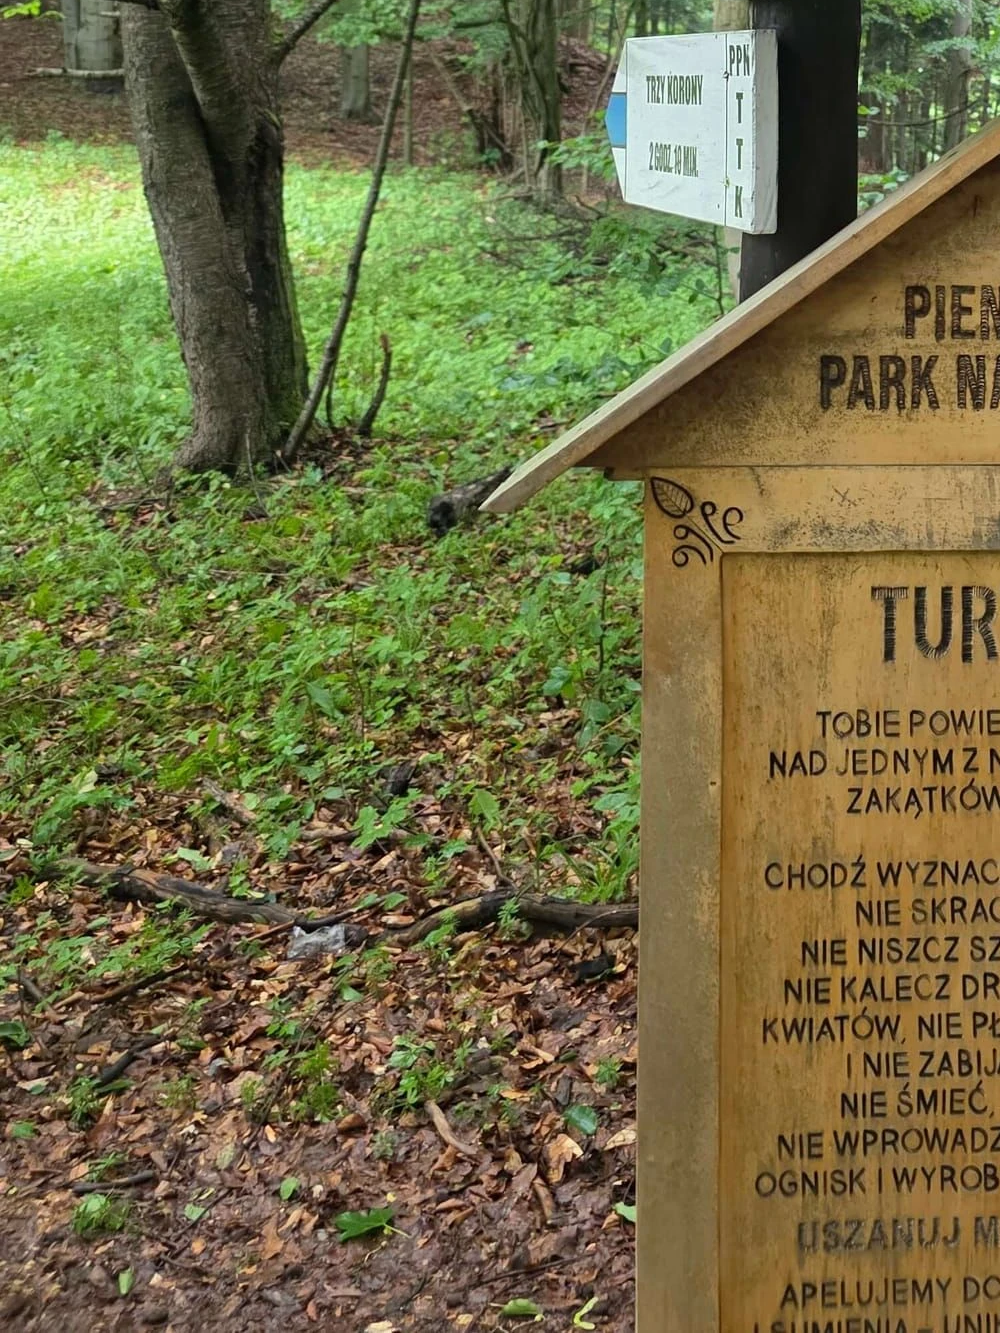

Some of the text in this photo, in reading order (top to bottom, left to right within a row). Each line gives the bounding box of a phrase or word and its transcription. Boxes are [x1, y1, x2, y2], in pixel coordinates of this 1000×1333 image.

[729, 44, 749, 76] PPN
[646, 75, 703, 105] TRZY KORONY
[736, 92, 743, 123] T
[649, 142, 654, 170] 2
[736, 139, 743, 169] T
[735, 186, 742, 218] K
[819, 354, 940, 411] PARK
[816, 710, 906, 739] TOBIE
[769, 749, 827, 778] NAD
[836, 748, 954, 777] JEDNYM
[962, 748, 979, 774] Z
[765, 854, 866, 890] CHODŹ
[856, 899, 900, 928] NIE
[801, 938, 847, 966] NIE
[858, 936, 959, 964] NISZCZ
[784, 977, 831, 1005] NIE
[841, 974, 950, 1004] KALECZ
[762, 1009, 906, 1044] KWIATÓW,
[918, 1012, 962, 1040] NIE
[846, 1053, 852, 1080] I
[864, 1051, 909, 1078] NIE
[840, 1092, 886, 1119] NIE
[896, 1081, 994, 1118] ŚMIEĆ,
[778, 1132, 823, 1160] NIE
[755, 1168, 866, 1198] OGNISK
[878, 1169, 883, 1195] I
[797, 1214, 962, 1256] USZANUJ
[780, 1276, 951, 1310] APELUJEMY
